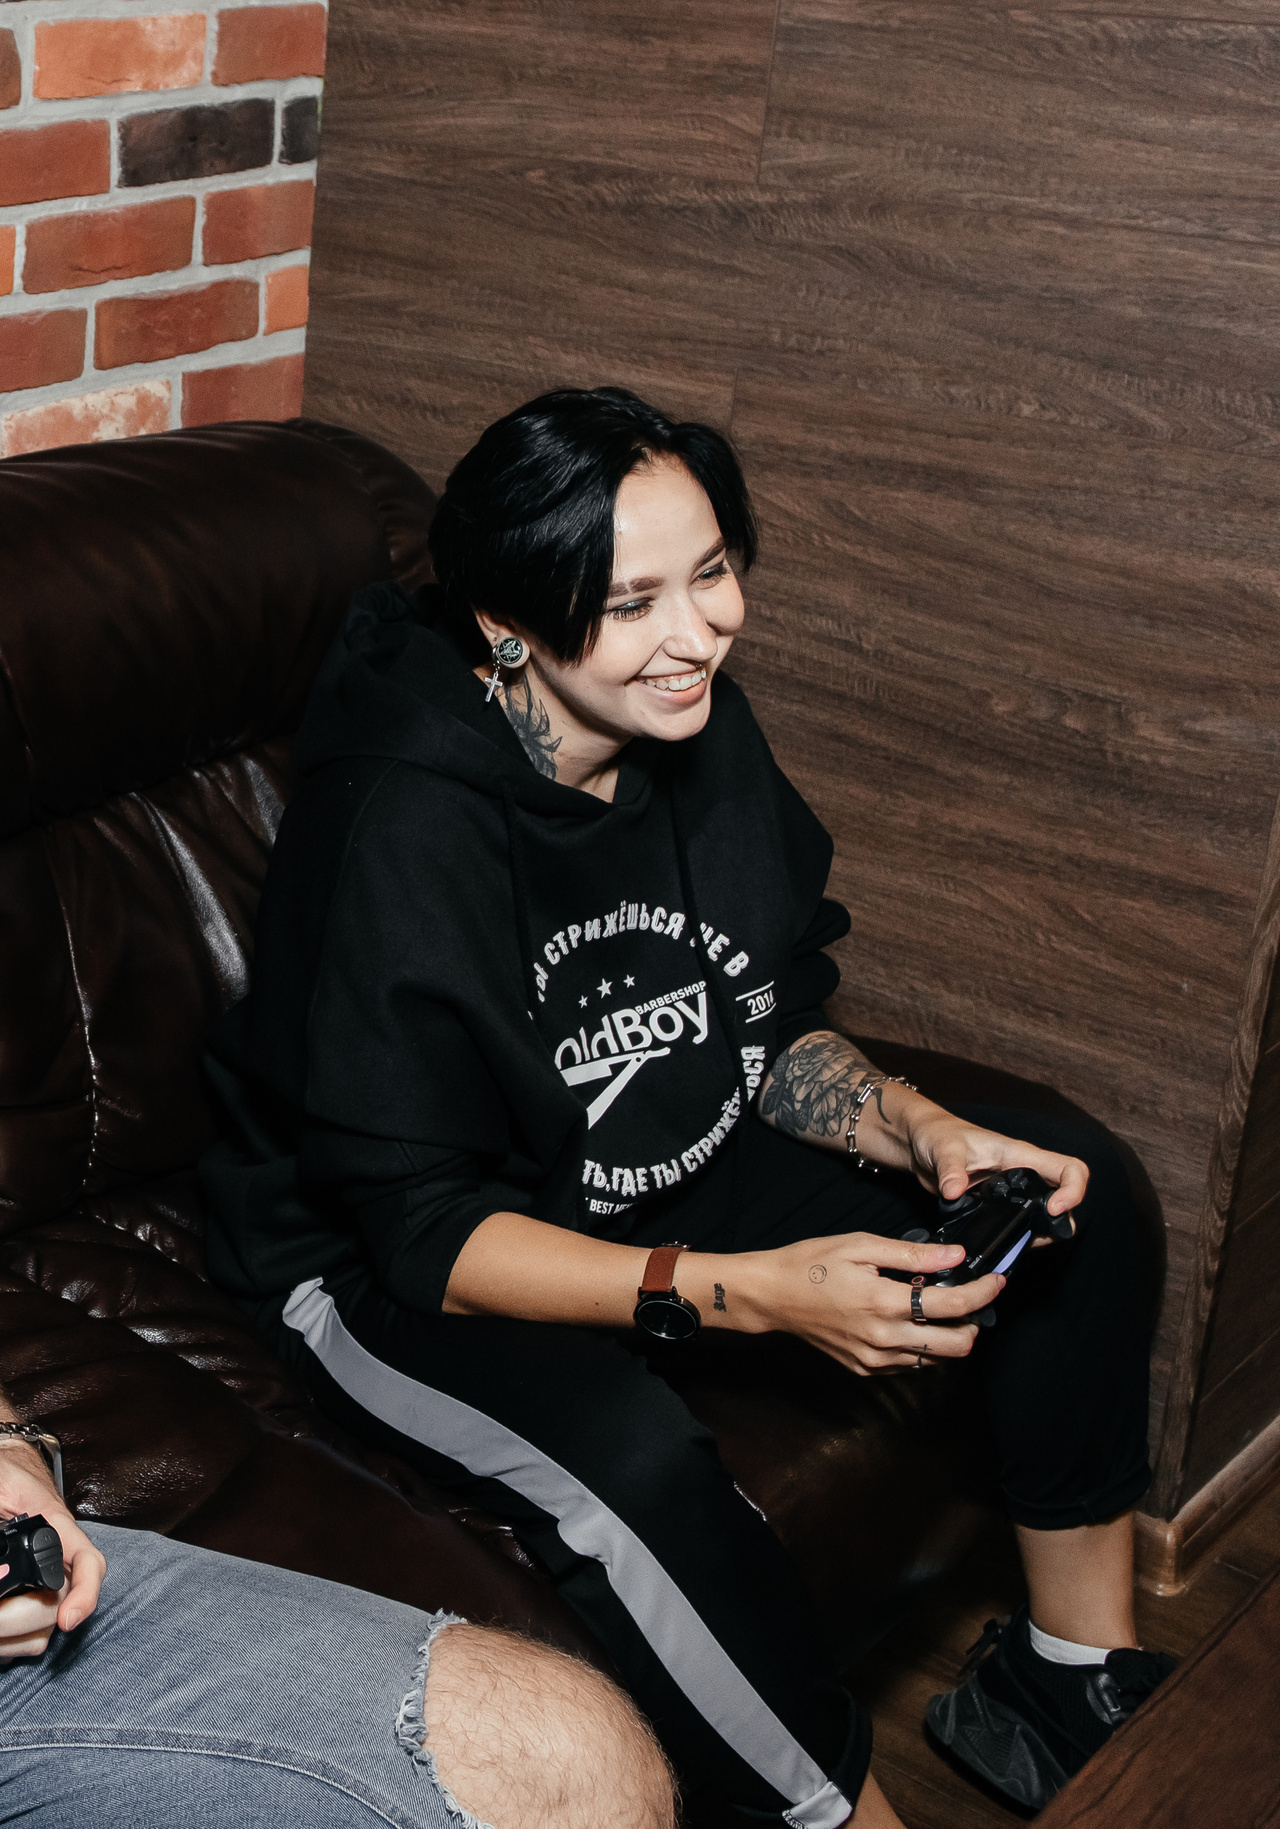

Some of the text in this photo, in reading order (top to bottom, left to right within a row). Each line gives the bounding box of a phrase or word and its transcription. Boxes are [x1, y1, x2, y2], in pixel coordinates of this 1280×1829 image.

[544, 900, 686, 965] СТРИЖЁШЬСЯ
[723, 951, 750, 977] В
[635, 980, 707, 1015] BARBERSHOP
[650, 1158, 682, 1189] ТЫ
[589, 1198, 615, 1215] BEST
